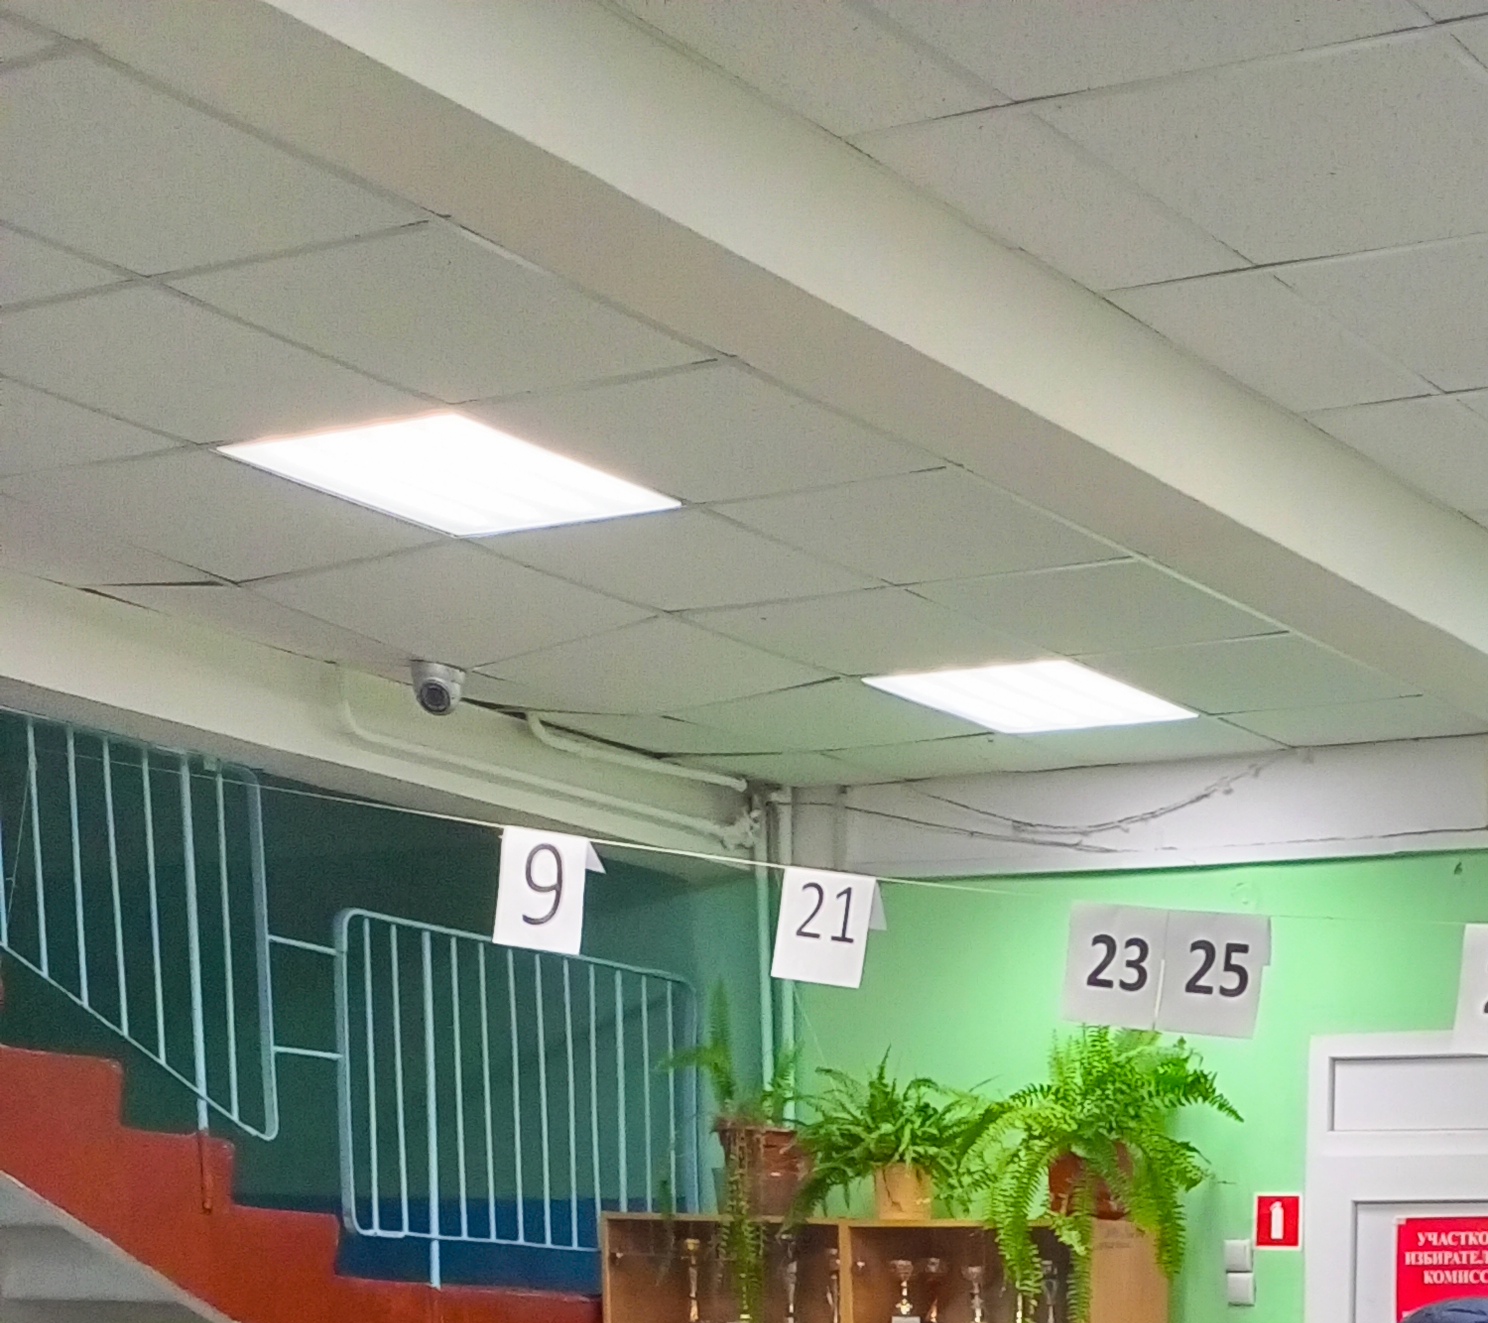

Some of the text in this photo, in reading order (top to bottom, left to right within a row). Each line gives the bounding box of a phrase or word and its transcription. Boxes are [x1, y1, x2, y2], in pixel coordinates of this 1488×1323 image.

[523, 844, 563, 925] 9
[796, 883, 854, 943] 21
[1087, 934, 1149, 992] 23
[1184, 939, 1250, 998] 25
